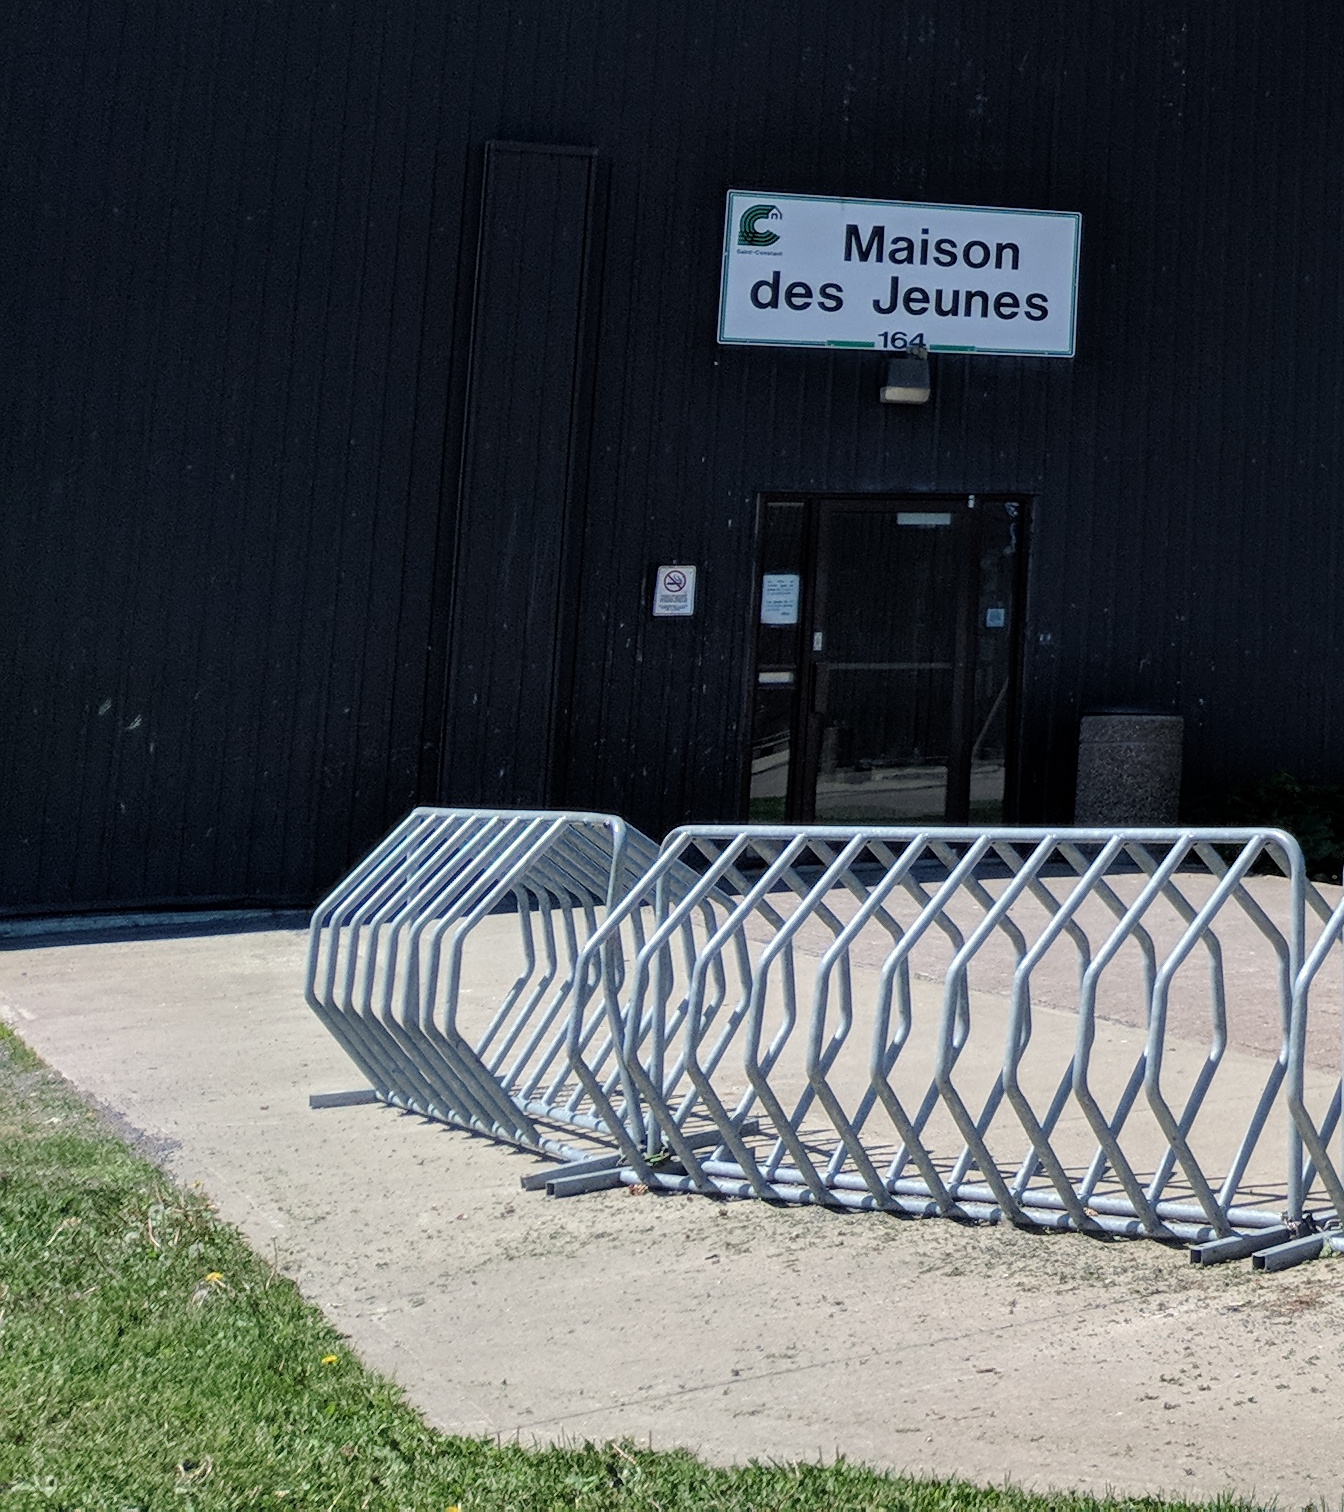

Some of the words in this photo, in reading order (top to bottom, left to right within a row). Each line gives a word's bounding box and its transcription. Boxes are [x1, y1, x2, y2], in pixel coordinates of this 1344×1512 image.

[843, 224, 1020, 270] Maison
[749, 270, 844, 312] des
[872, 275, 1049, 322] Jeunes
[877, 331, 926, 349] 164
